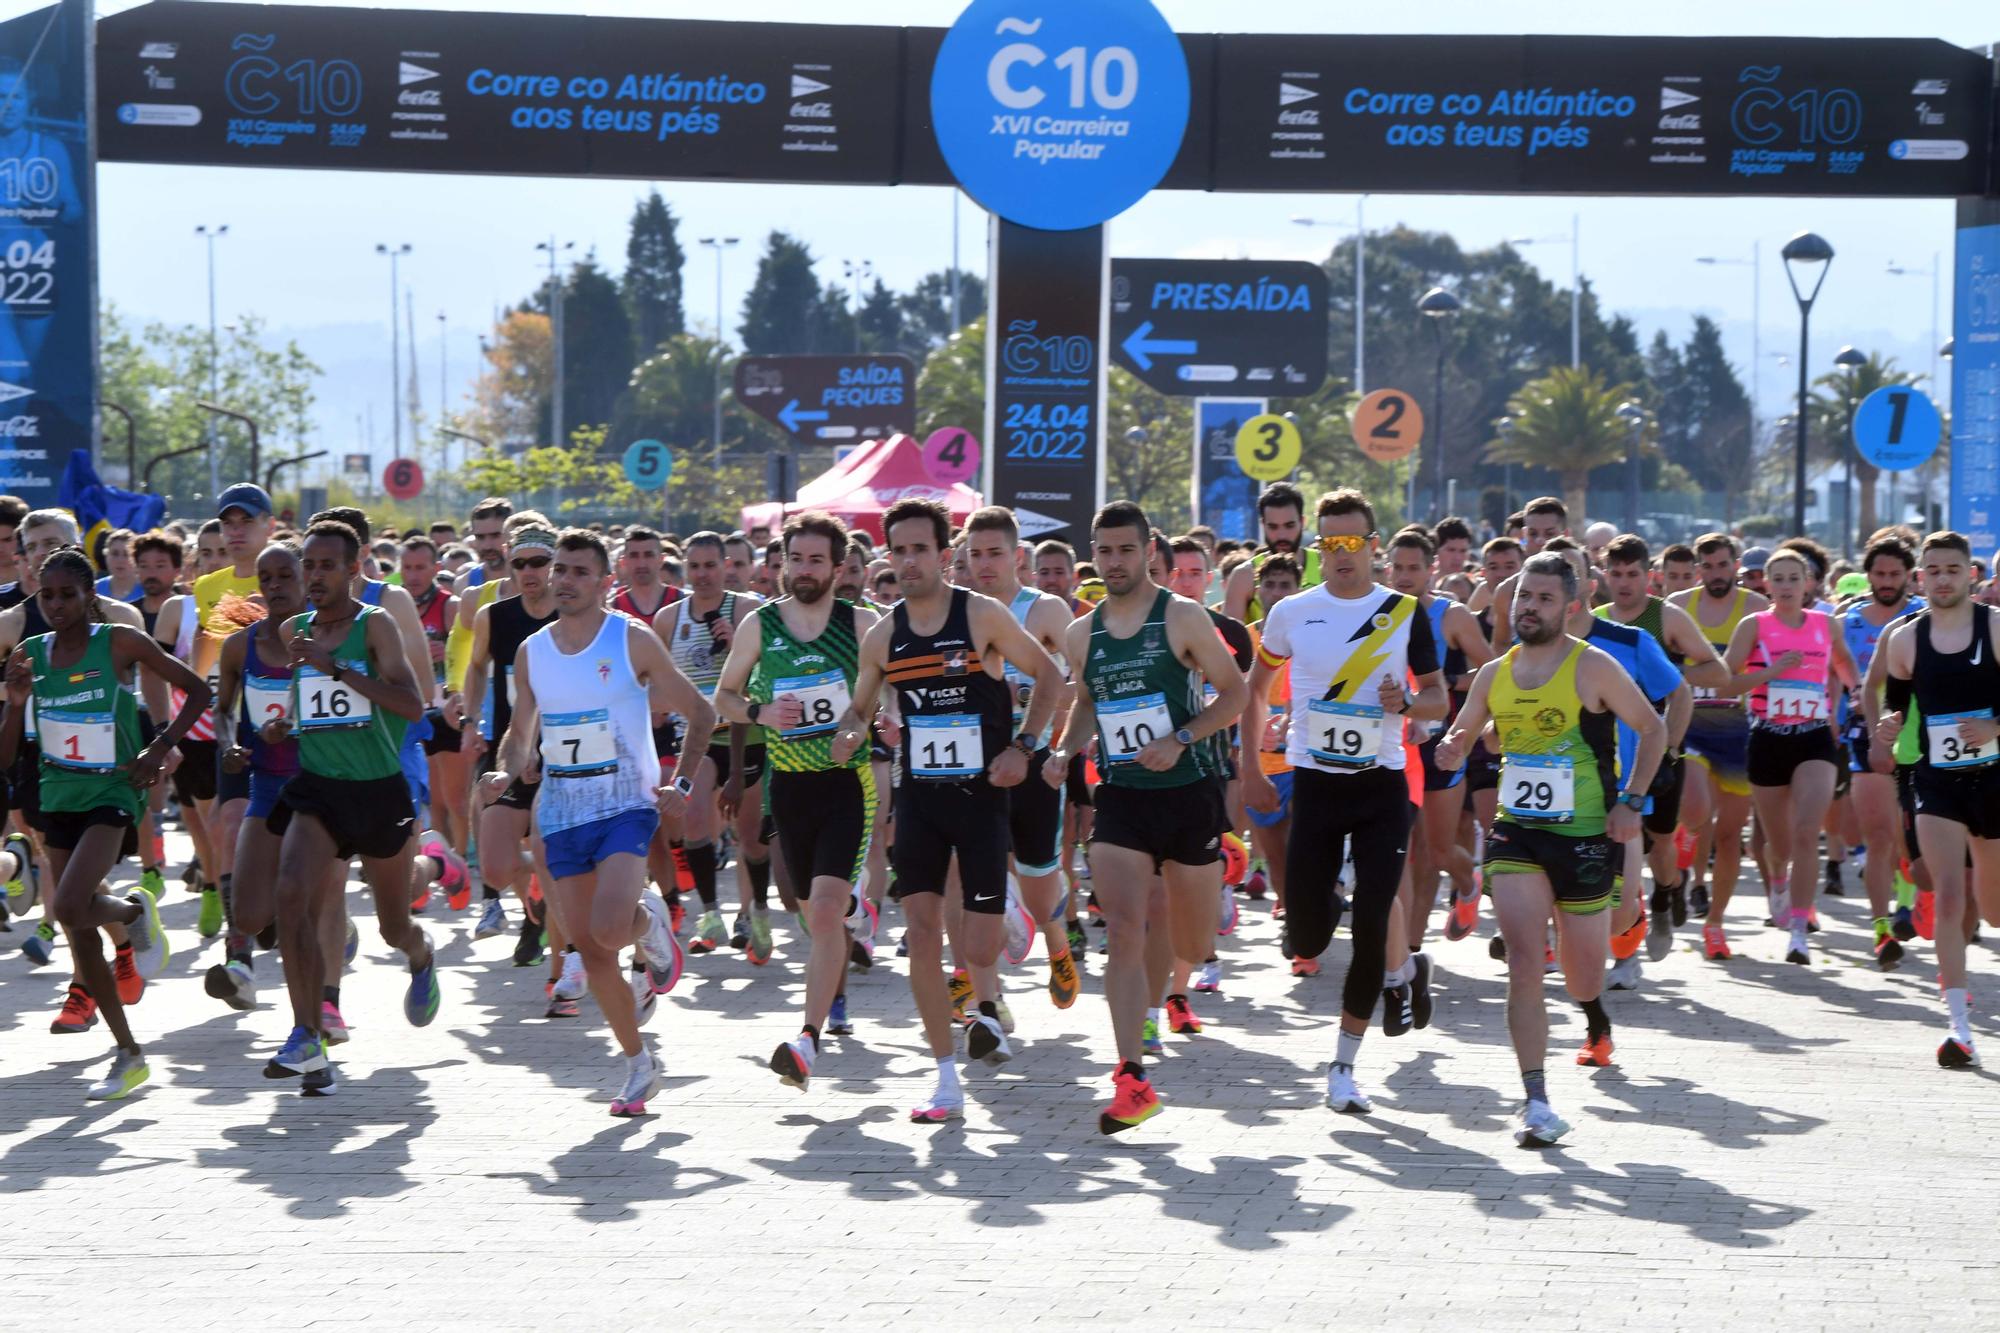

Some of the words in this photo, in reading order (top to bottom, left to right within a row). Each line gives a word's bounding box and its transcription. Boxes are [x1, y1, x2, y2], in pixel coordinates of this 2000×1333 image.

[467, 69, 560, 98] Corre
[568, 77, 608, 100] co
[615, 72, 766, 104] Atlántico
[1344, 88, 1433, 115] Corre
[1440, 95, 1482, 116] co
[1488, 87, 1636, 118] Atlántico
[511, 106, 572, 130] aos
[582, 105, 652, 132] teus
[658, 106, 720, 141] pés
[989, 115, 1031, 134] XVI
[1034, 115, 1130, 136] Carreira
[1386, 124, 1446, 146] aos
[1454, 121, 1523, 147] teus
[1528, 119, 1590, 155] pés
[1013, 139, 1105, 165] Popular
[1151, 277, 1311, 312] PRESAÍDA
[838, 363, 903, 385] SAÍDA
[822, 387, 903, 407] PEQUES
[1004, 404, 1089, 429] 24.04
[1370, 396, 1405, 439] 2
[1887, 393, 1909, 443] 1
[938, 433, 966, 468] 4
[1007, 431, 1087, 459] 2022
[1253, 422, 1284, 462] 3
[393, 462, 412, 487] 6
[637, 446, 660, 476] 5
[929, 686, 967, 699] VICKY
[1112, 679, 1146, 694] JACA
[310, 689, 350, 719] 16
[798, 698, 834, 727] 18
[932, 696, 966, 707] FOODS
[1773, 698, 1819, 719] 117
[64, 734, 86, 761] 1
[562, 738, 581, 764] 7
[1116, 723, 1154, 753] 10
[1322, 727, 1363, 756] 19
[922, 740, 964, 768] 11
[1514, 781, 1554, 811] 29
